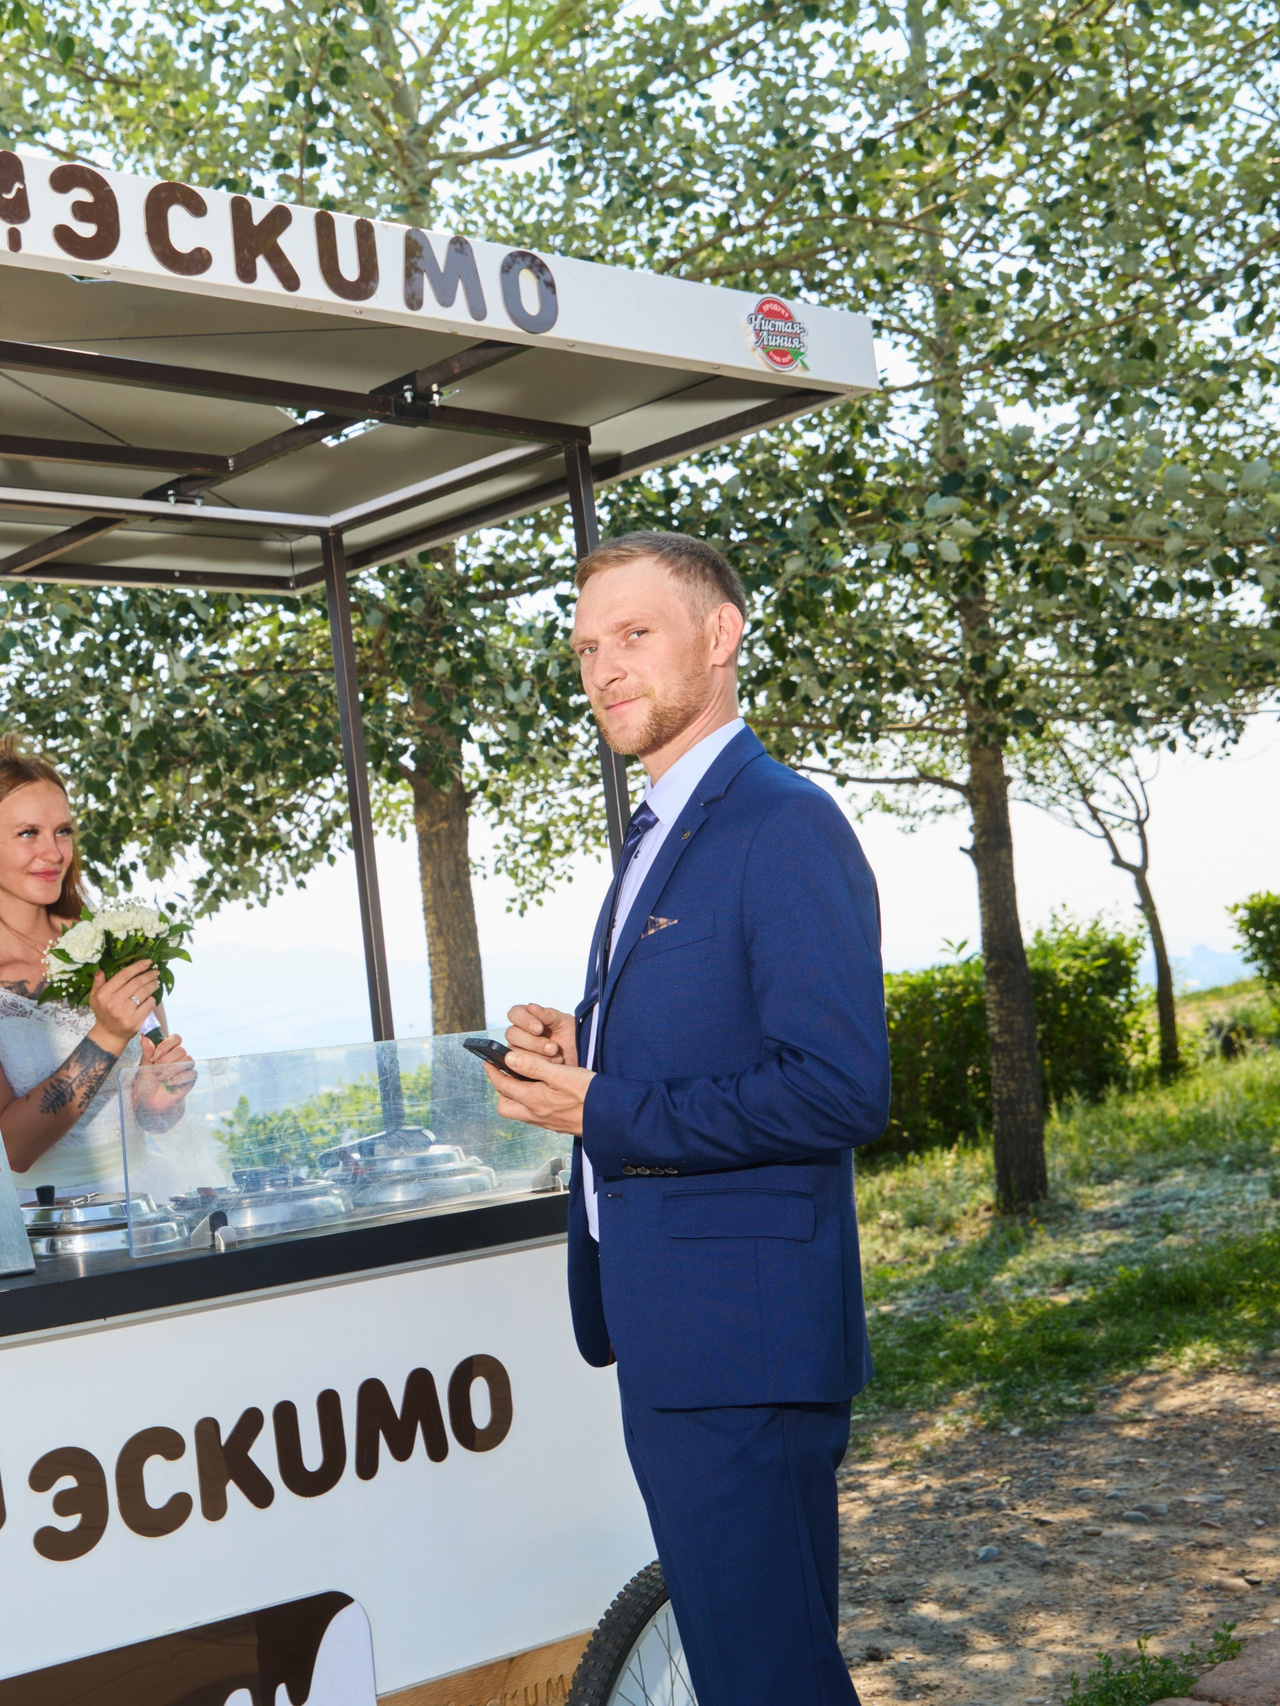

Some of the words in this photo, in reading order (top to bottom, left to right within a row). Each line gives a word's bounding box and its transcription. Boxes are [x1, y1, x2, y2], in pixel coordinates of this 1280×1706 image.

[762, 303, 789, 318] ПРОДУКТ
[747, 313, 806, 335] Чистая
[755, 331, 805, 350] Линия
